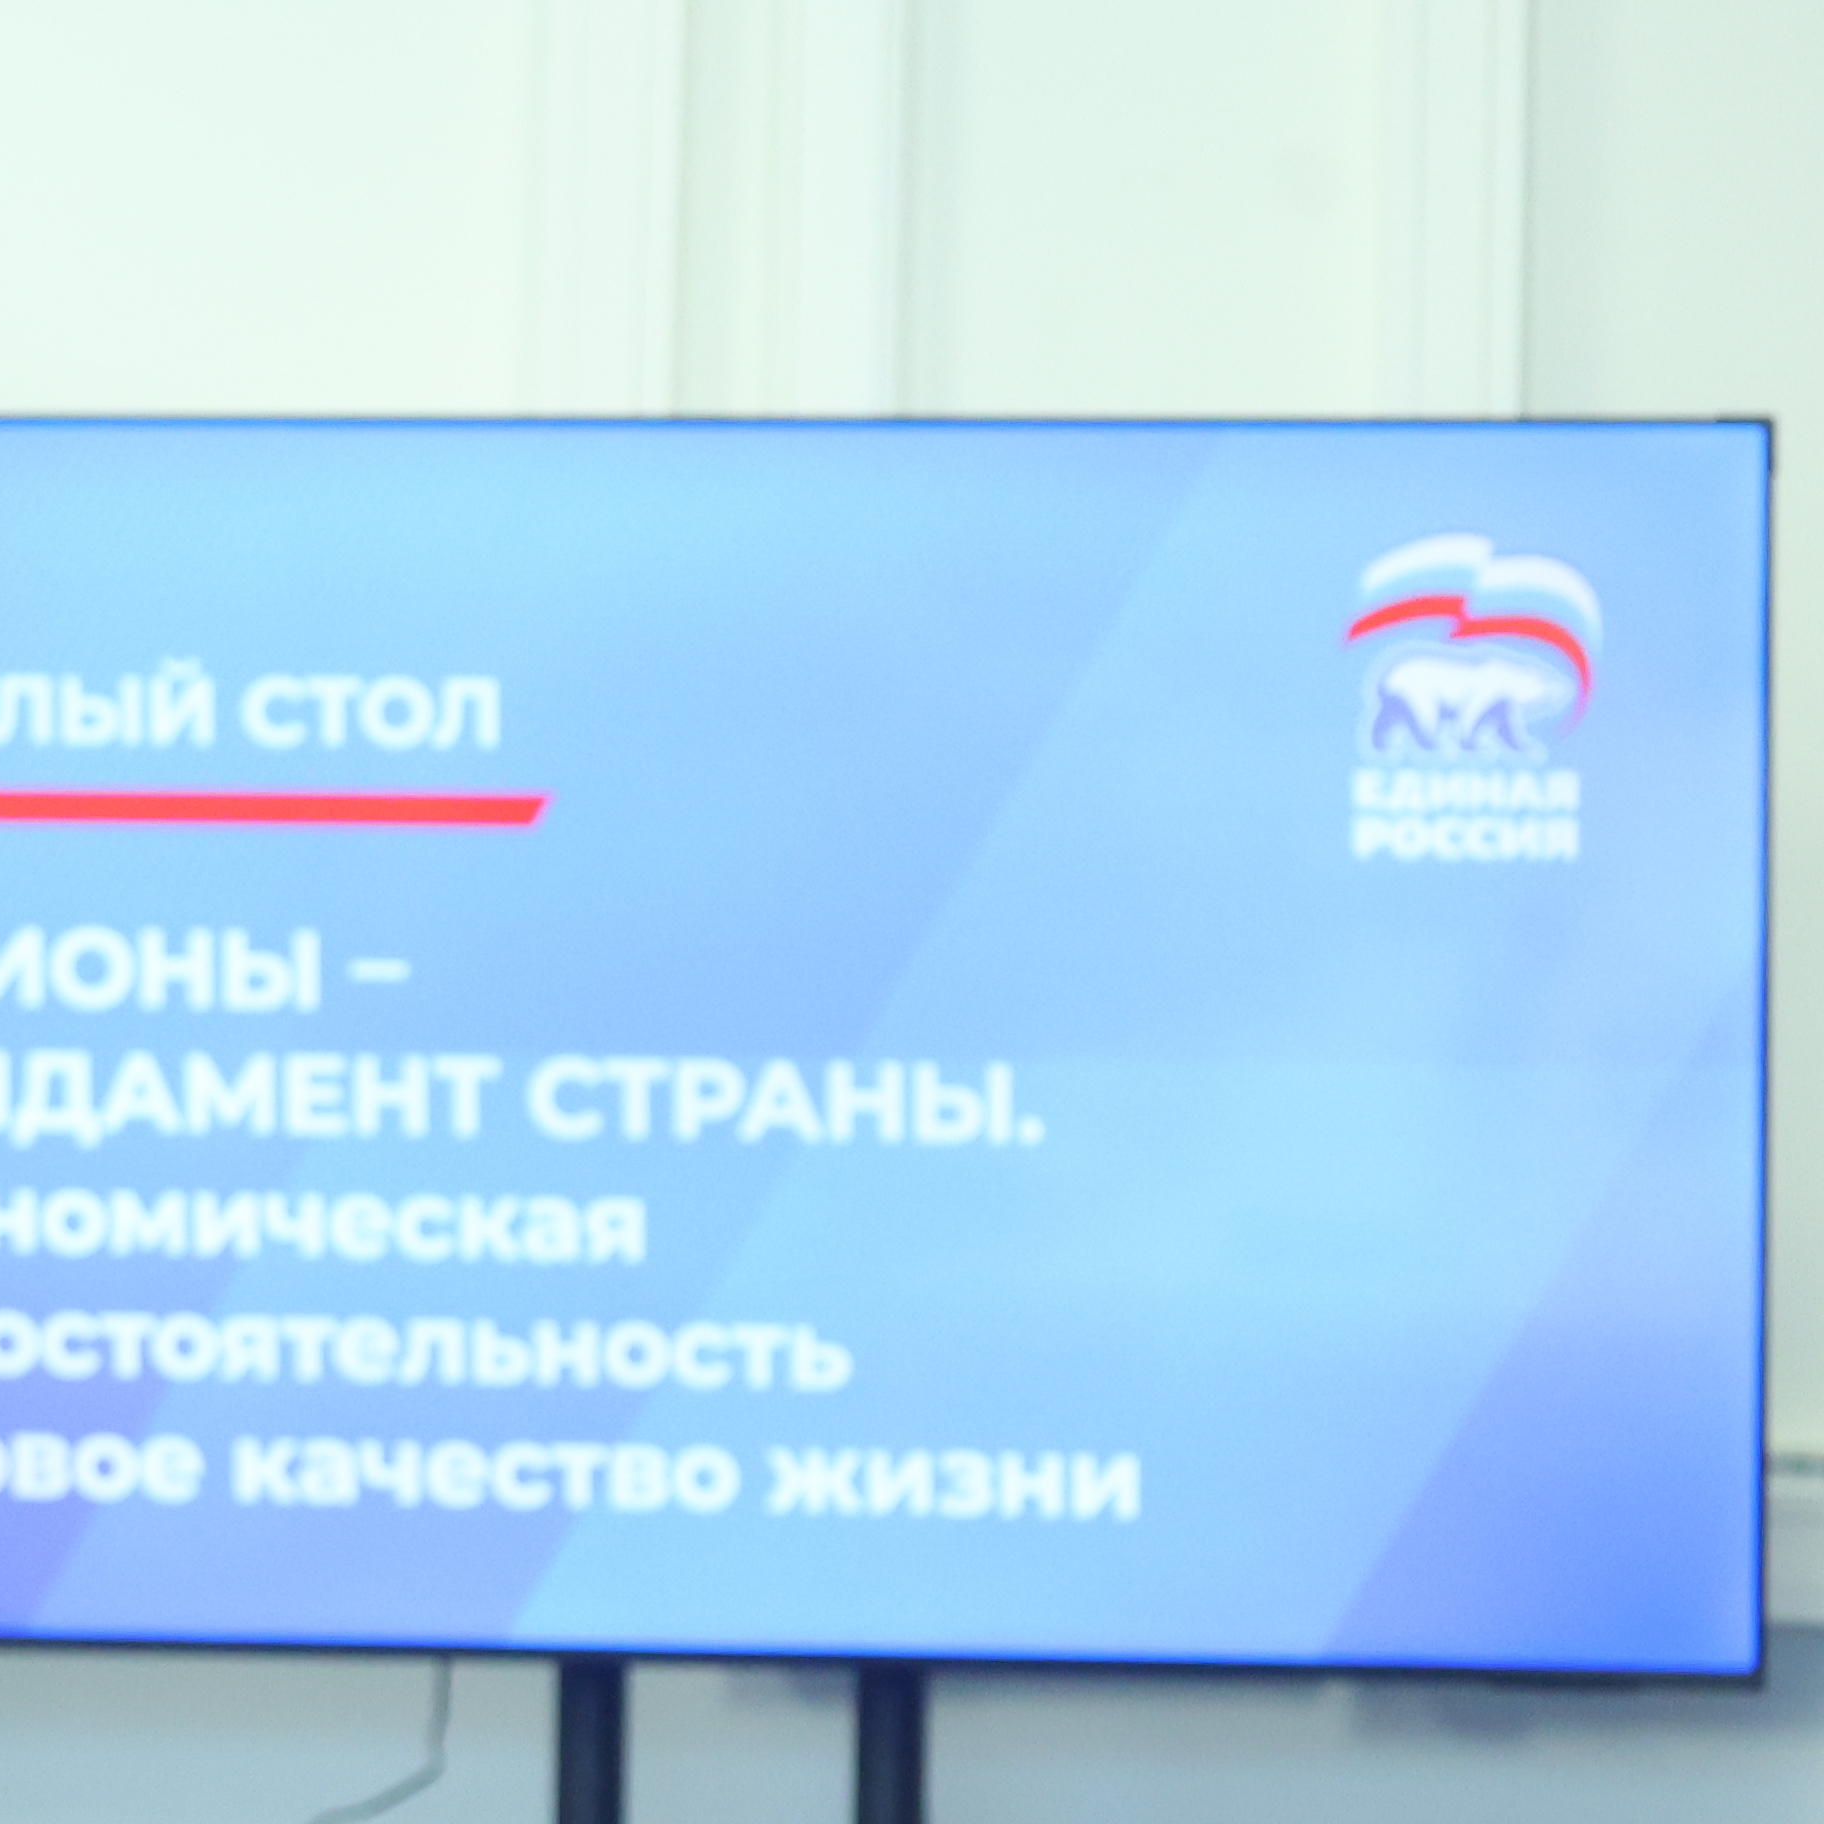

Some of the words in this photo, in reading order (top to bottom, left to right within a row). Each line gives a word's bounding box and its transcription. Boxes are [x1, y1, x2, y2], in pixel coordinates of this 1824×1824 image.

[238, 676, 502, 752] СТОЛ
[1353, 768, 1579, 817] ЕДИНАЯ
[1353, 811, 1579, 861] РОССИЯ
[525, 1054, 1046, 1146] СТРАНЫ.
[232, 1435, 742, 1514] качество
[767, 1446, 1142, 1521] жизни
